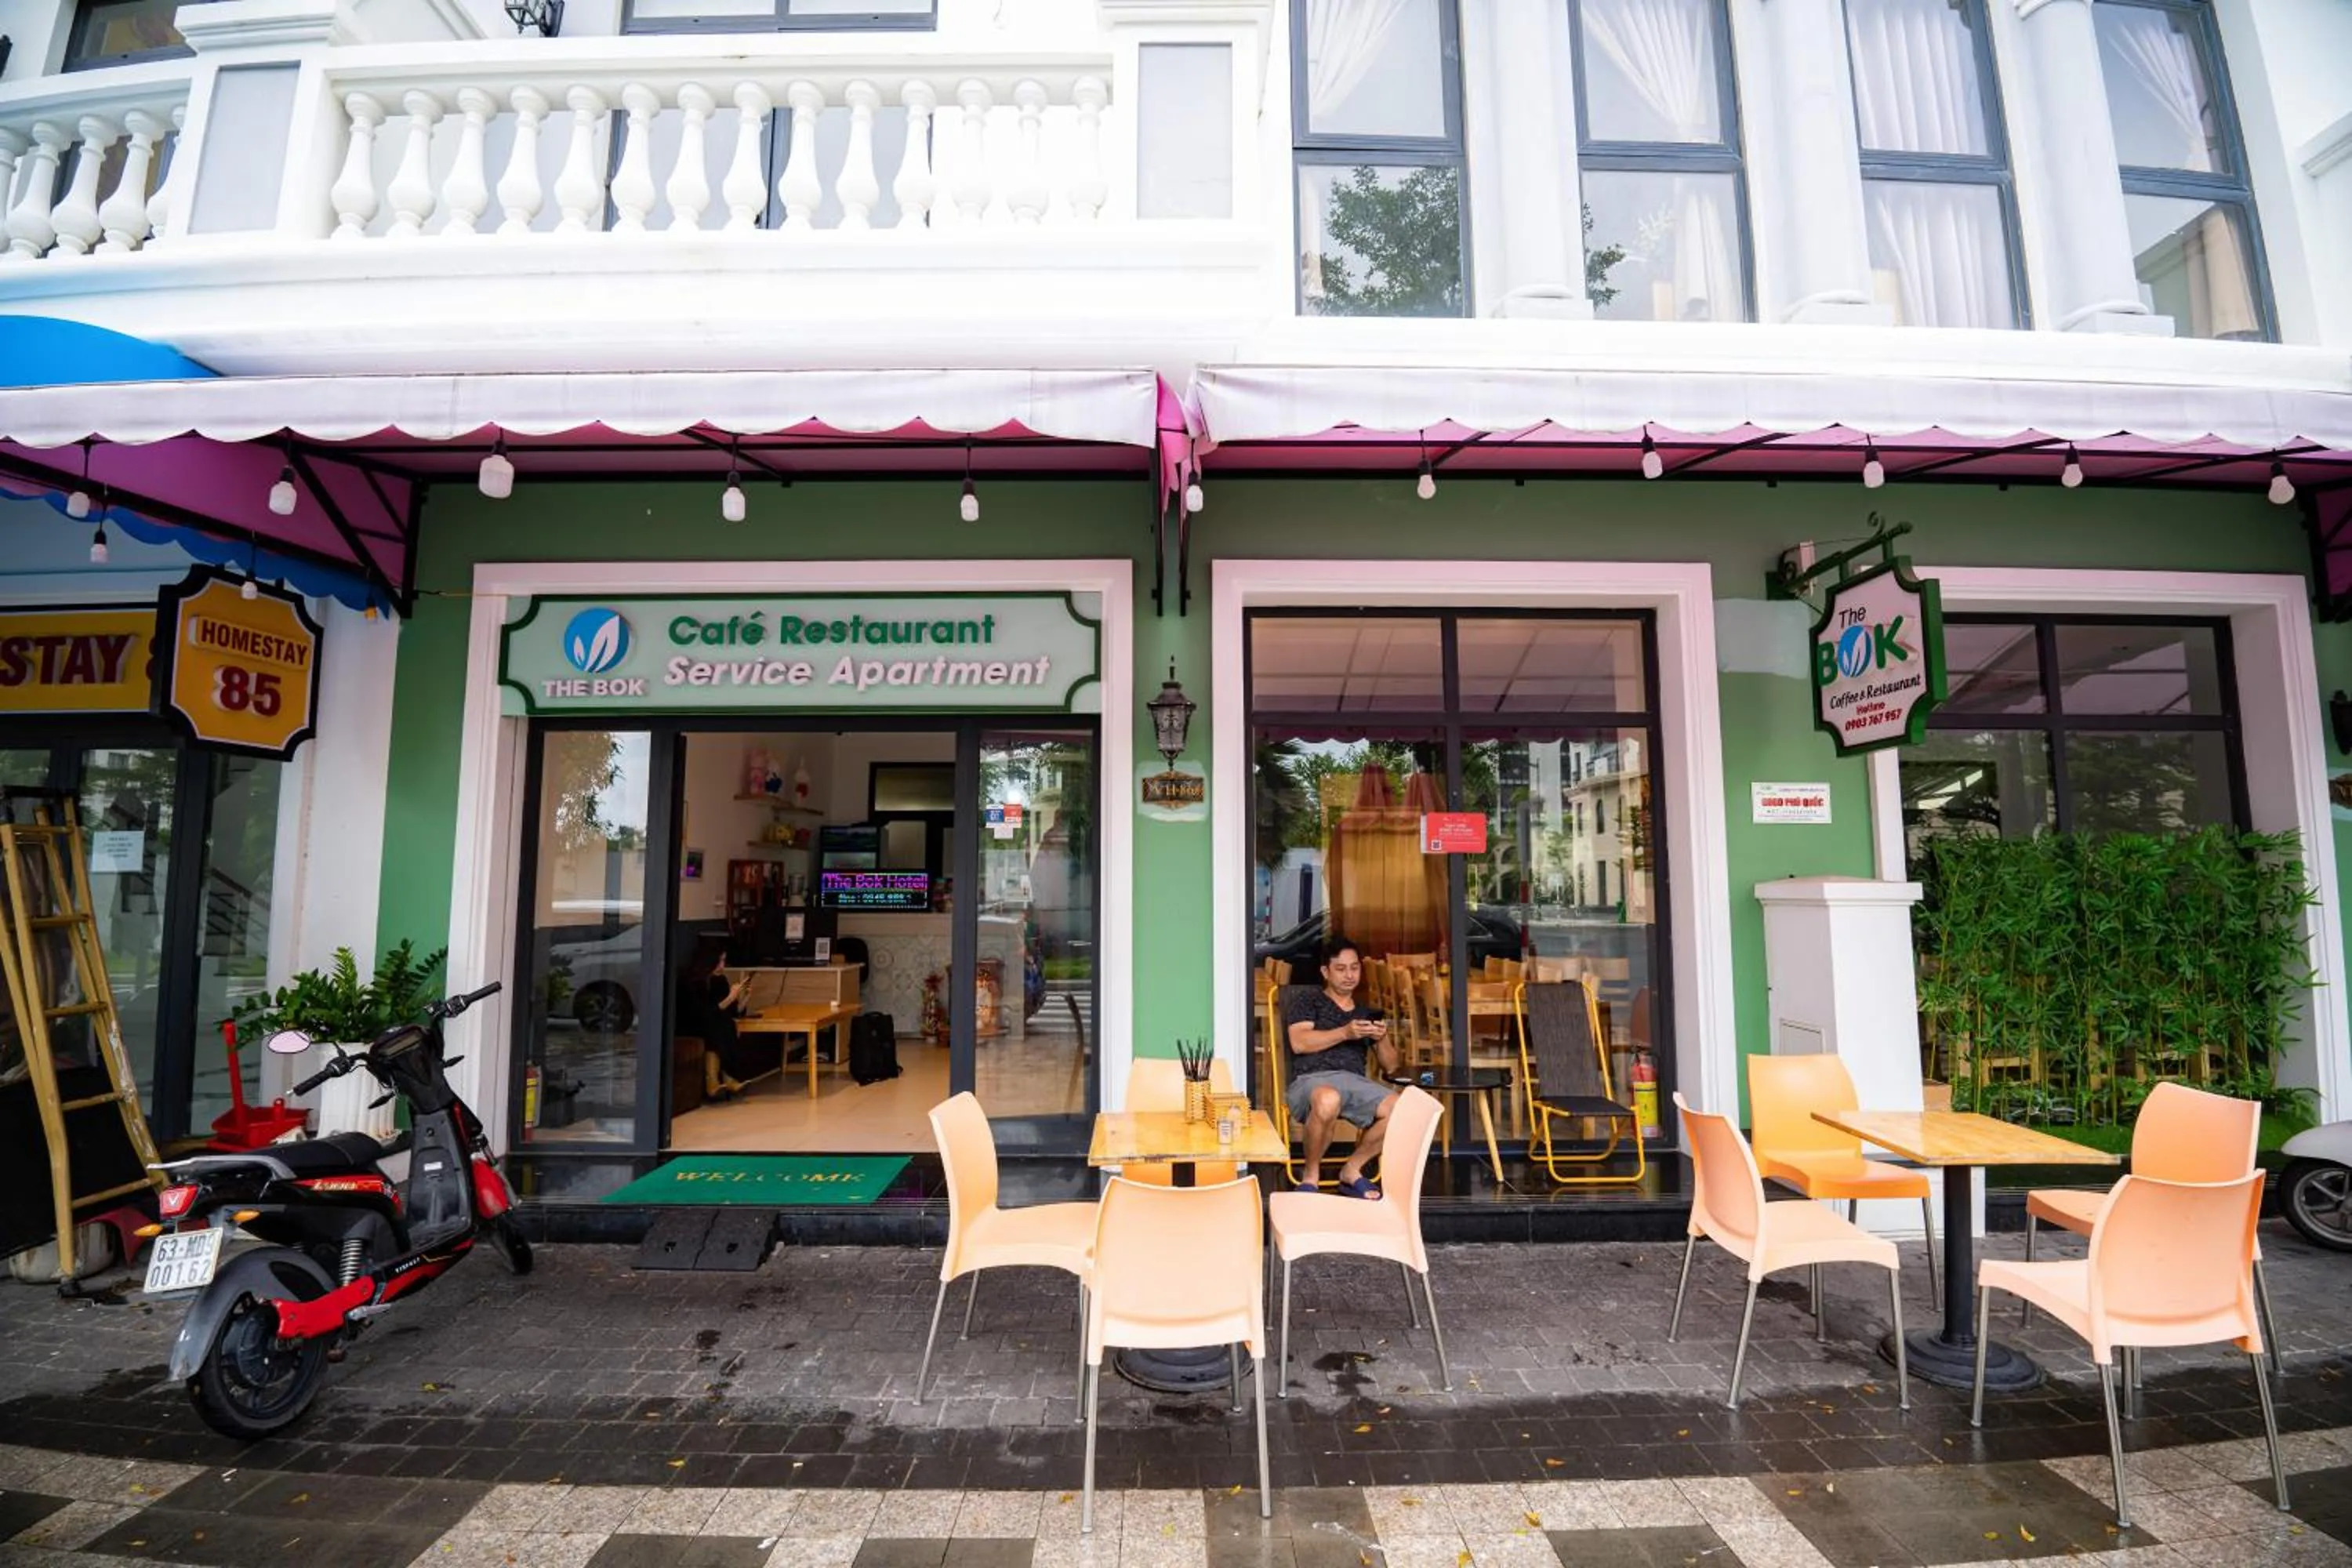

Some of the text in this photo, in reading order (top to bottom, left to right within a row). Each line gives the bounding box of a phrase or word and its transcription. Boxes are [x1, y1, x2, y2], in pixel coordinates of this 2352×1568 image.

[668, 611, 995, 645] Café Restaurant
[1839, 606, 1866, 626] The
[201, 619, 307, 666] HOMESTAY
[542, 678, 646, 697] THE BOK
[664, 655, 1051, 691] Service Apartment
[220, 665, 281, 717] 85
[1830, 691, 1859, 710] Coffee
[1867, 674, 1921, 699] Restaurant
[826, 873, 925, 888] The Bok Hotel
